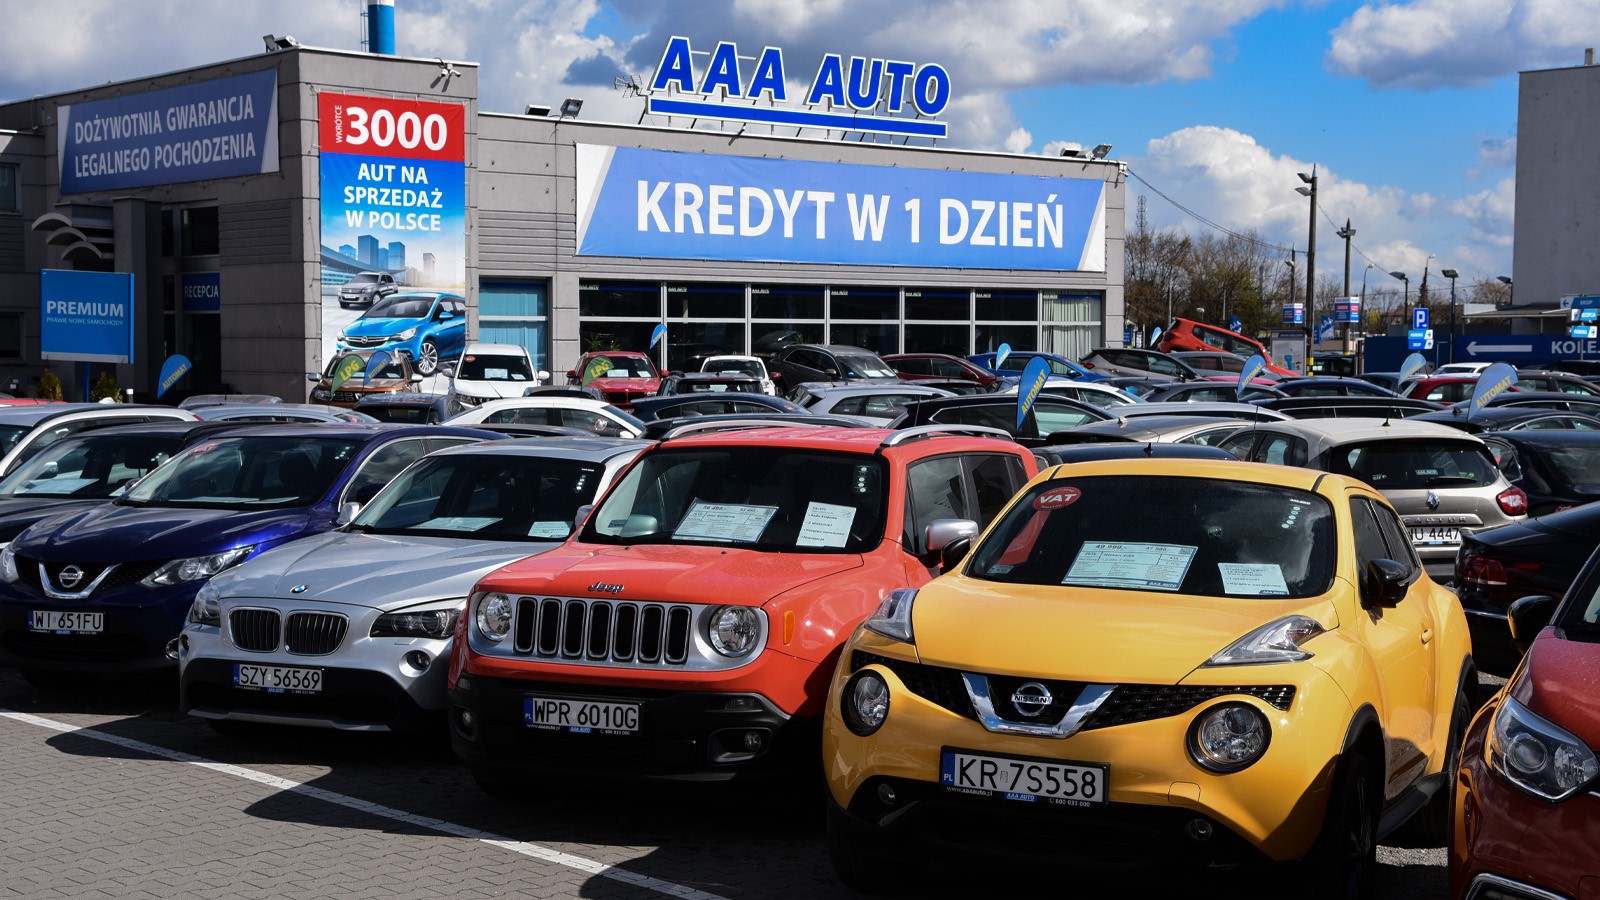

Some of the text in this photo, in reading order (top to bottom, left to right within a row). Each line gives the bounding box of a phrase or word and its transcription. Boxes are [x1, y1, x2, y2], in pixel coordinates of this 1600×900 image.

[647, 36, 950, 117] AAA AUTO
[75, 94, 254, 144] DOŻYWOTNIA GWARANCJA
[334, 105, 342, 144] WKRÓTCE
[346, 106, 448, 151] 3000
[75, 132, 256, 178] LEGALNEGO POCHODZENIA
[358, 163, 428, 184] AUT NA
[344, 186, 443, 208] SPRZEDAŻ
[345, 210, 441, 232] W POLSCE
[637, 180, 1063, 248] KREDYT W 1 DZIEŃ
[184, 286, 218, 298] RECEPCJA
[46, 300, 124, 317] PREMIUM
[1416, 310, 1426, 327] P
[1552, 341, 1600, 354] KOLE
[162, 364, 187, 390] AUTOMAT
[340, 360, 360, 382] LPG
[591, 360, 609, 378] LPG
[1021, 369, 1047, 414] AUTOMAT
[1476, 375, 1511, 408] AUTOMAT
[1040, 494, 1077, 504] VAT
[588, 581, 624, 594] Jeep
[58, 613, 102, 630] 651FU
[240, 666, 320, 690] SZY 56569
[1014, 695, 1048, 703] NISSAN
[534, 700, 637, 730] WPR 6010G
[944, 773, 953, 782] PL
[959, 757, 1096, 798] KR 7S558
[946, 786, 992, 797] www.aaaauto.pl
